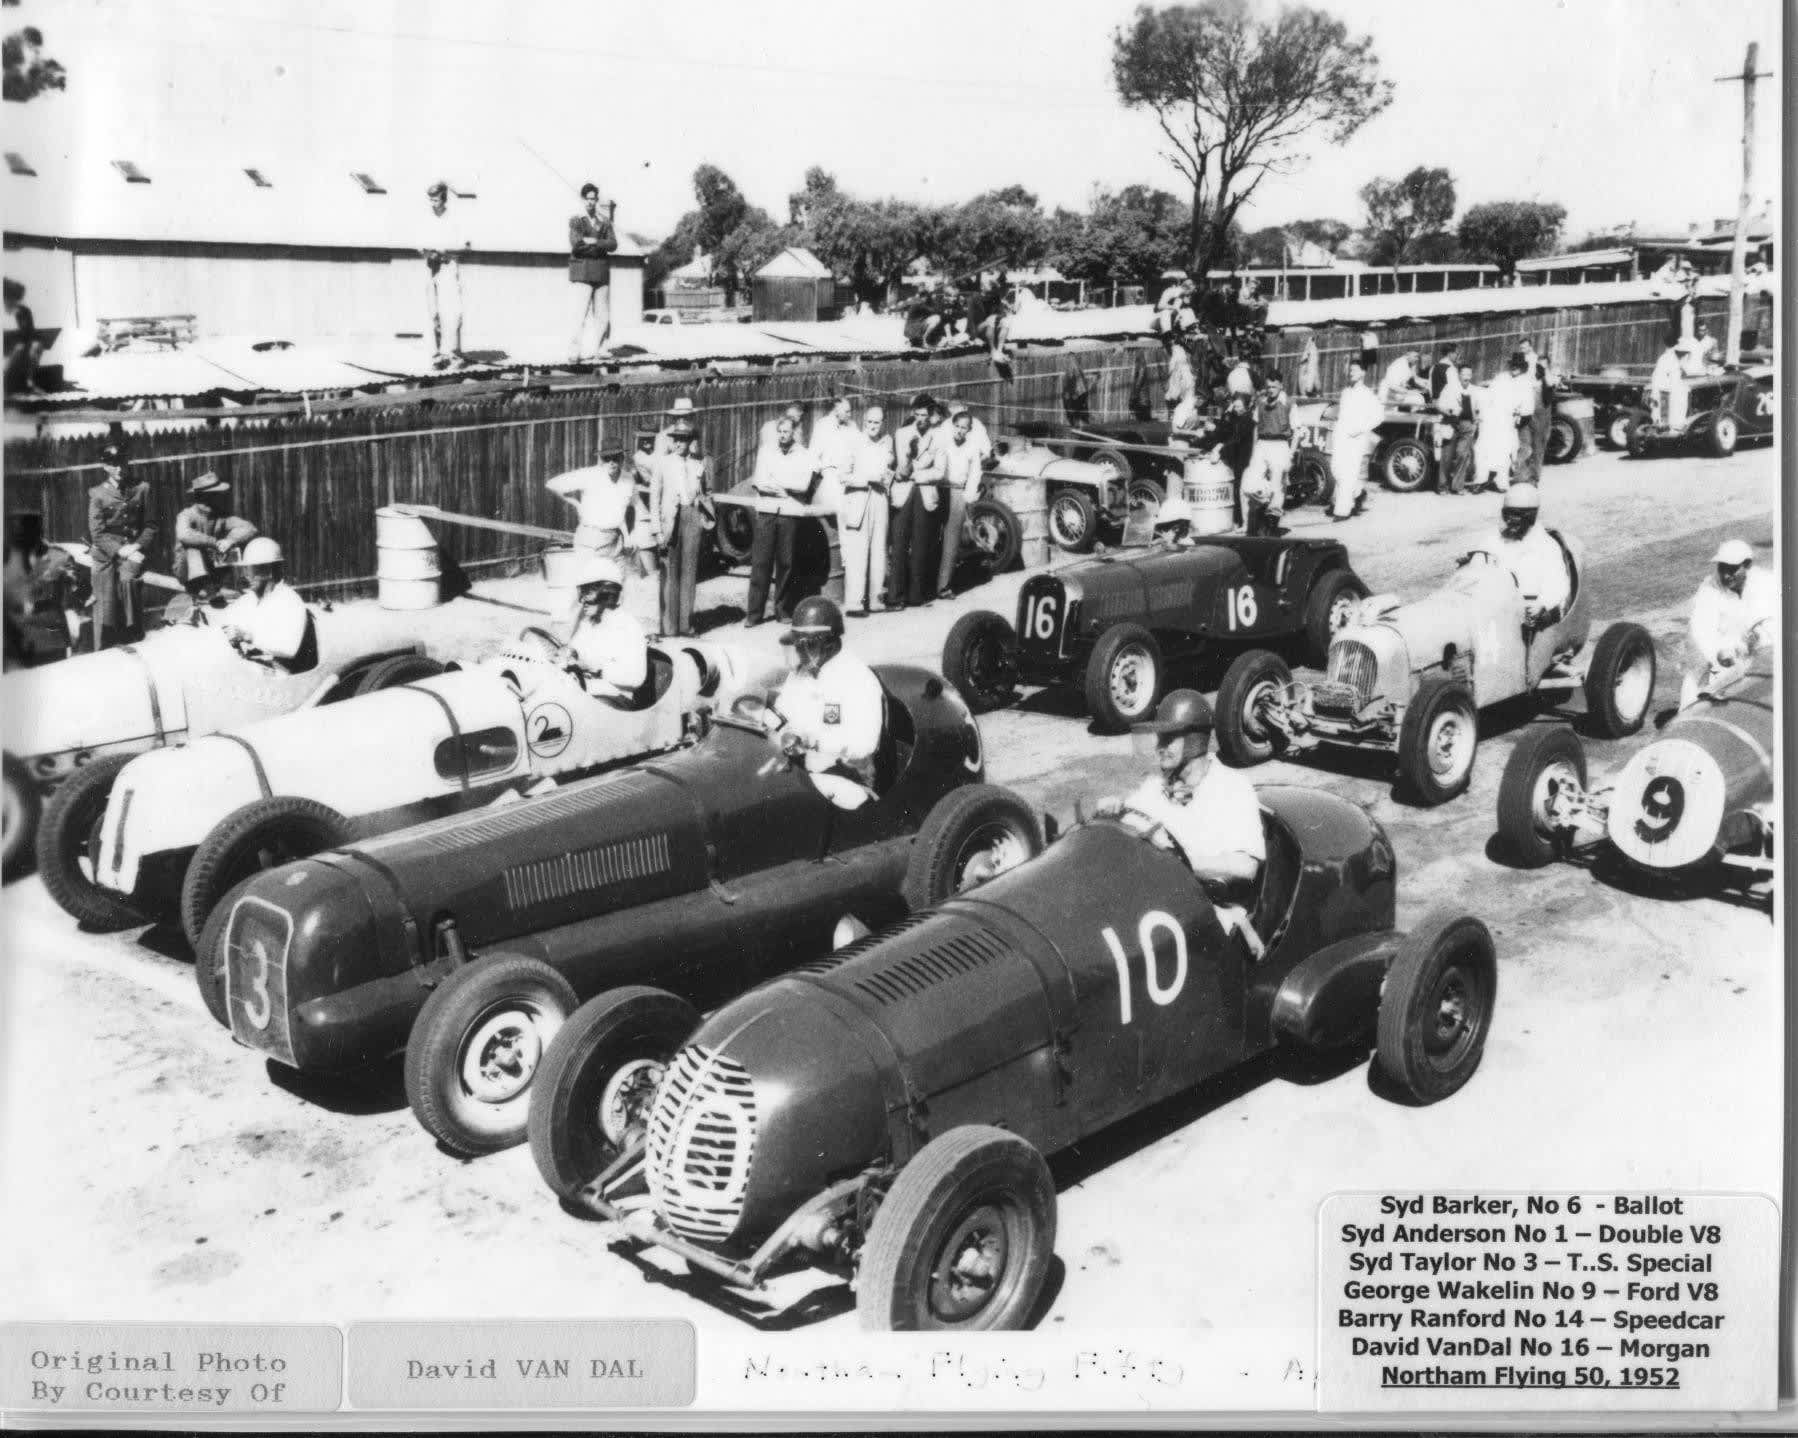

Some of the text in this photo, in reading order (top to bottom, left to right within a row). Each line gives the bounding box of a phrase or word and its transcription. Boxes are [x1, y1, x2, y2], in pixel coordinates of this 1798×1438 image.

[1024, 595, 1057, 639] 16
[1227, 585, 1258, 632] 16
[1633, 775, 1686, 845] 9
[244, 939, 272, 1031] 3
[1101, 909, 1189, 1026] 10
